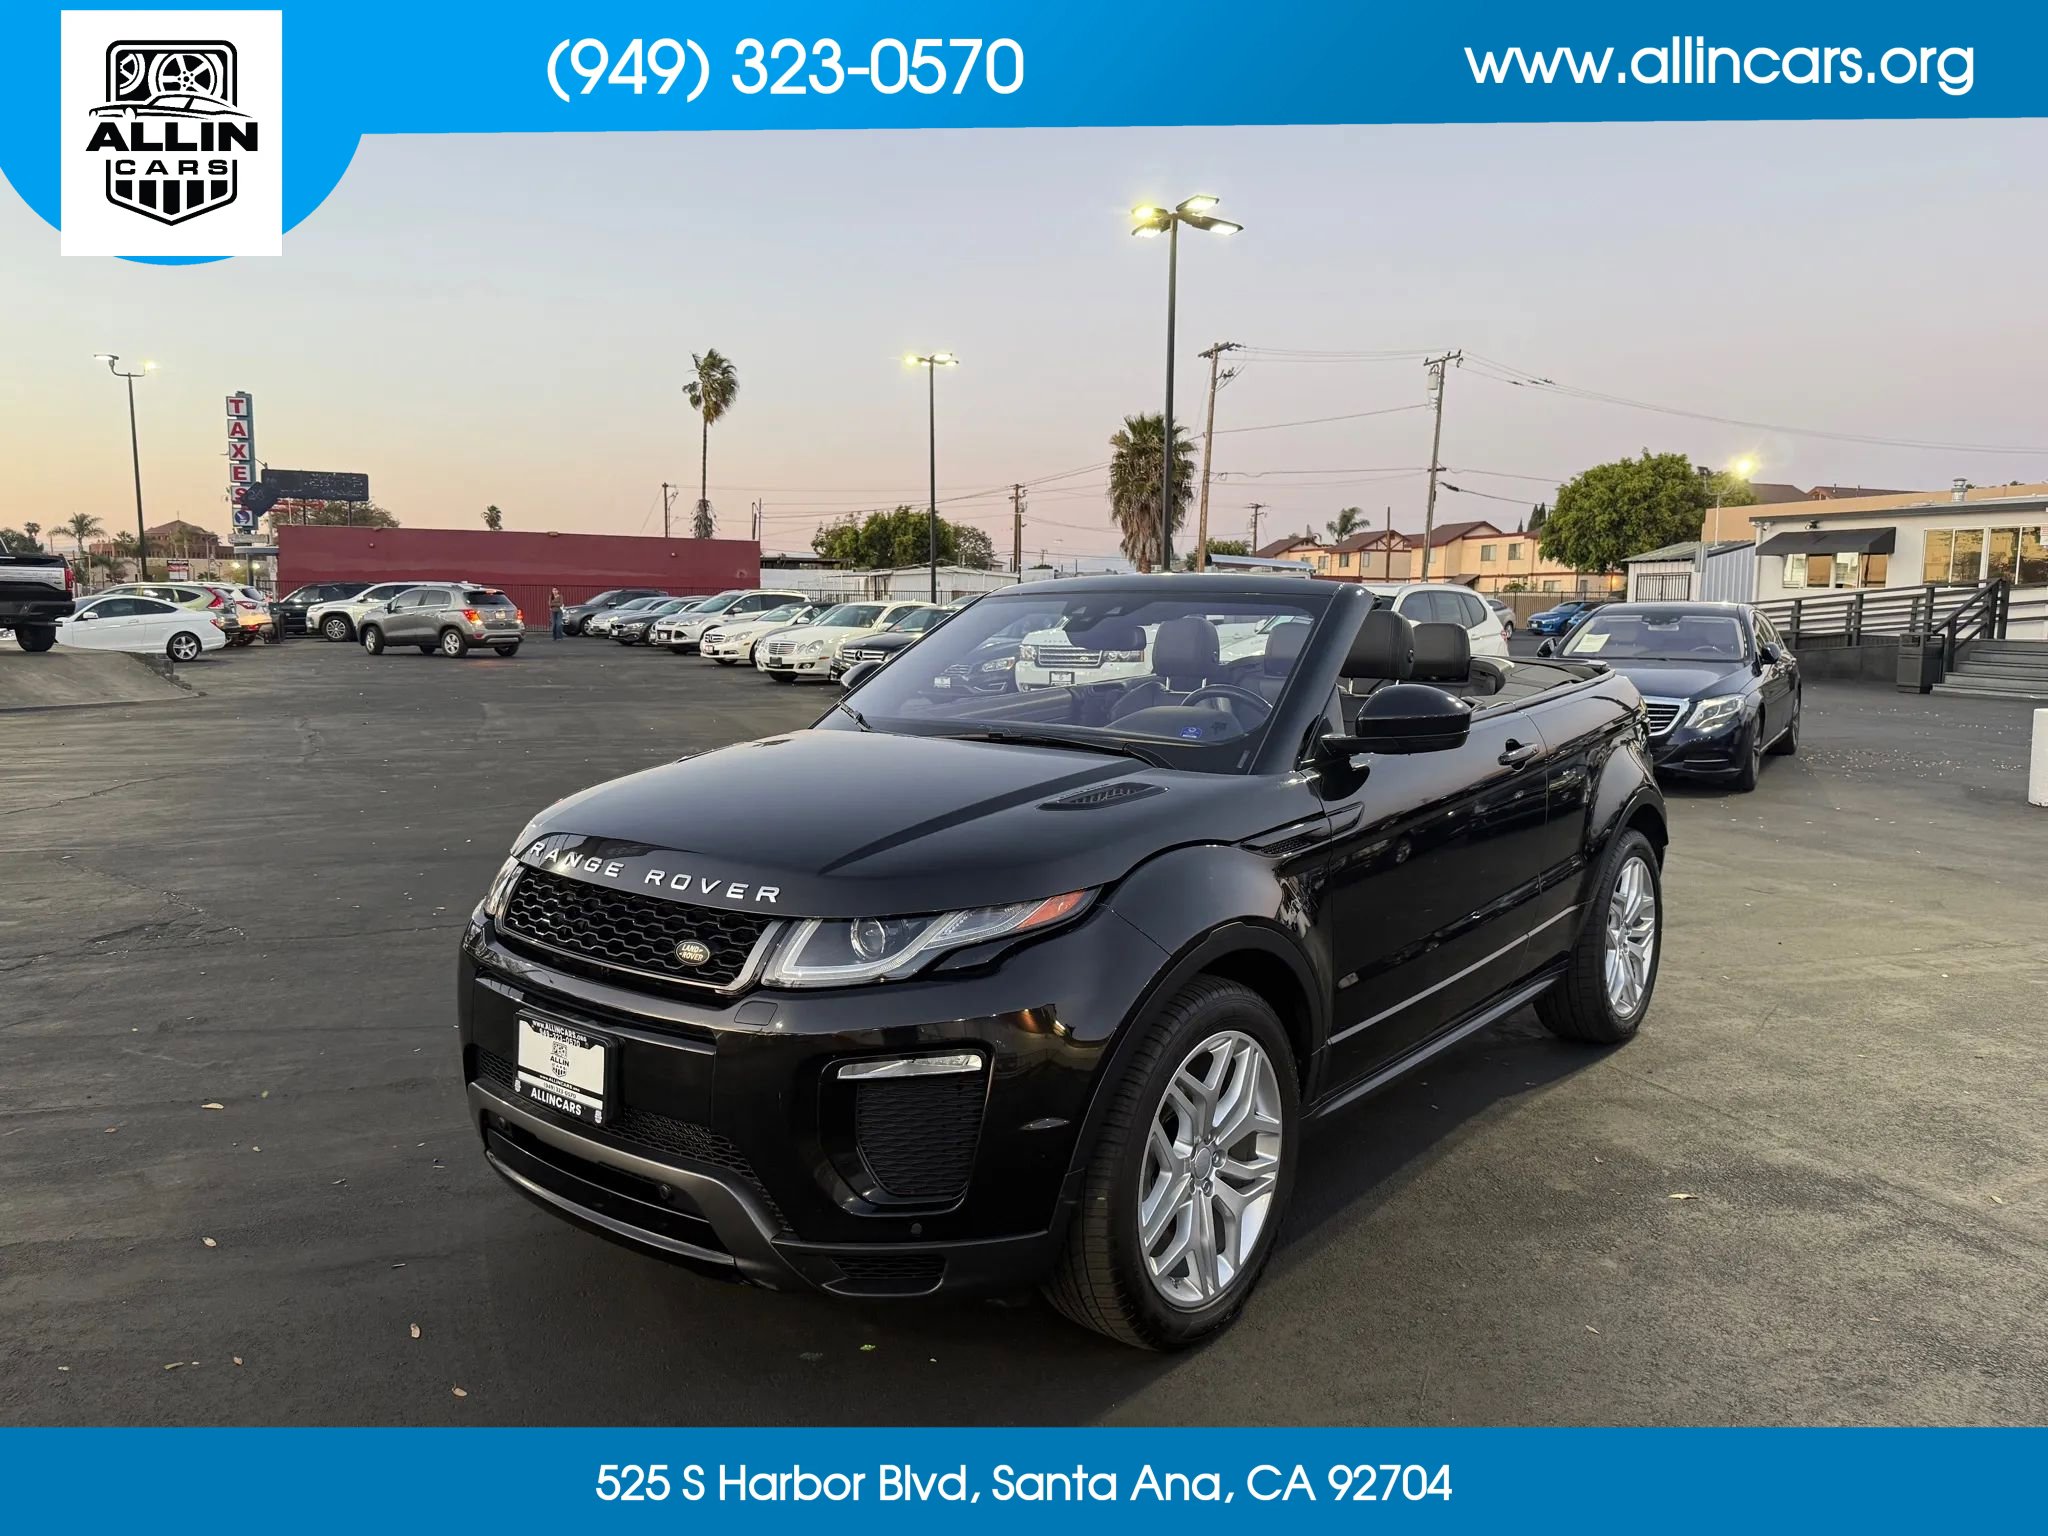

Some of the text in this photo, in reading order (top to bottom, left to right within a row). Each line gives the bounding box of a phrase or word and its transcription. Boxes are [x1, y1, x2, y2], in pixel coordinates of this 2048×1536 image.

[229, 399, 248, 504] TAXES
[530, 841, 780, 903] RANGE ROVER
[550, 1055, 570, 1067] ALLIN
[530, 1087, 582, 1116] ALLINCARS
